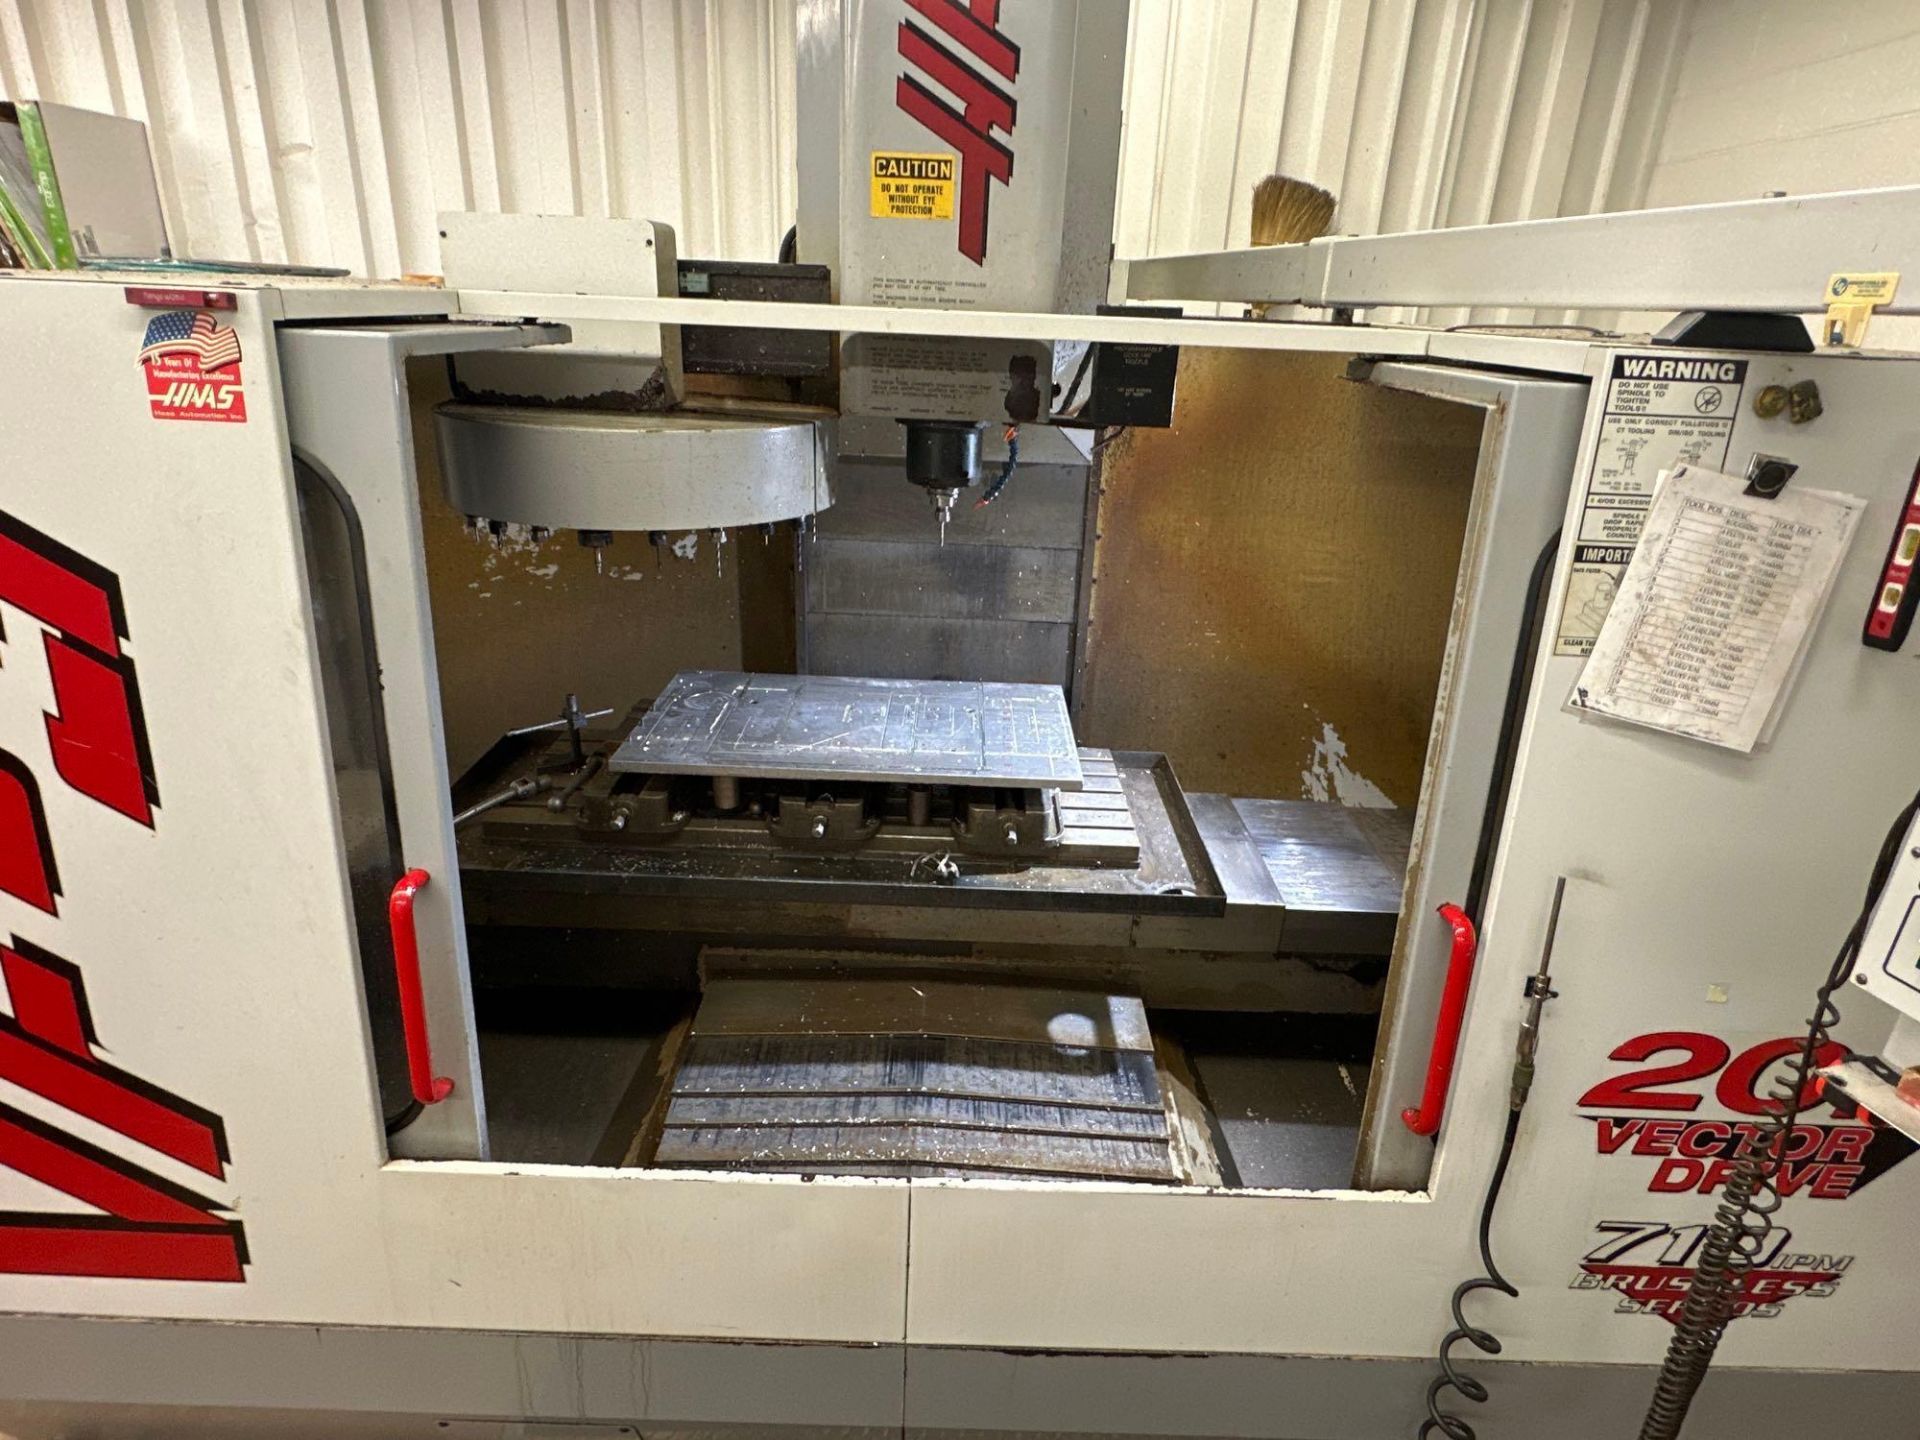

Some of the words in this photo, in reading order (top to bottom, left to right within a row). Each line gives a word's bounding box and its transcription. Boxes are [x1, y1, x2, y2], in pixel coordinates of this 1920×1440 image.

[876, 159, 950, 178] CAUTION
[881, 183, 891, 193] DO
[895, 184, 908, 194] NOT
[913, 185, 944, 195] OPERATE
[888, 194, 919, 204] WITHOUT
[923, 196, 936, 205] EYE
[891, 205, 933, 216] PROTECTION
[1623, 359, 1736, 380] WARNING
[149, 383, 243, 409] HAAS
[1616, 397, 1650, 405] TIGHTEN
[180, 410, 227, 419] Automation
[1628, 427, 1655, 435] TOOLING
